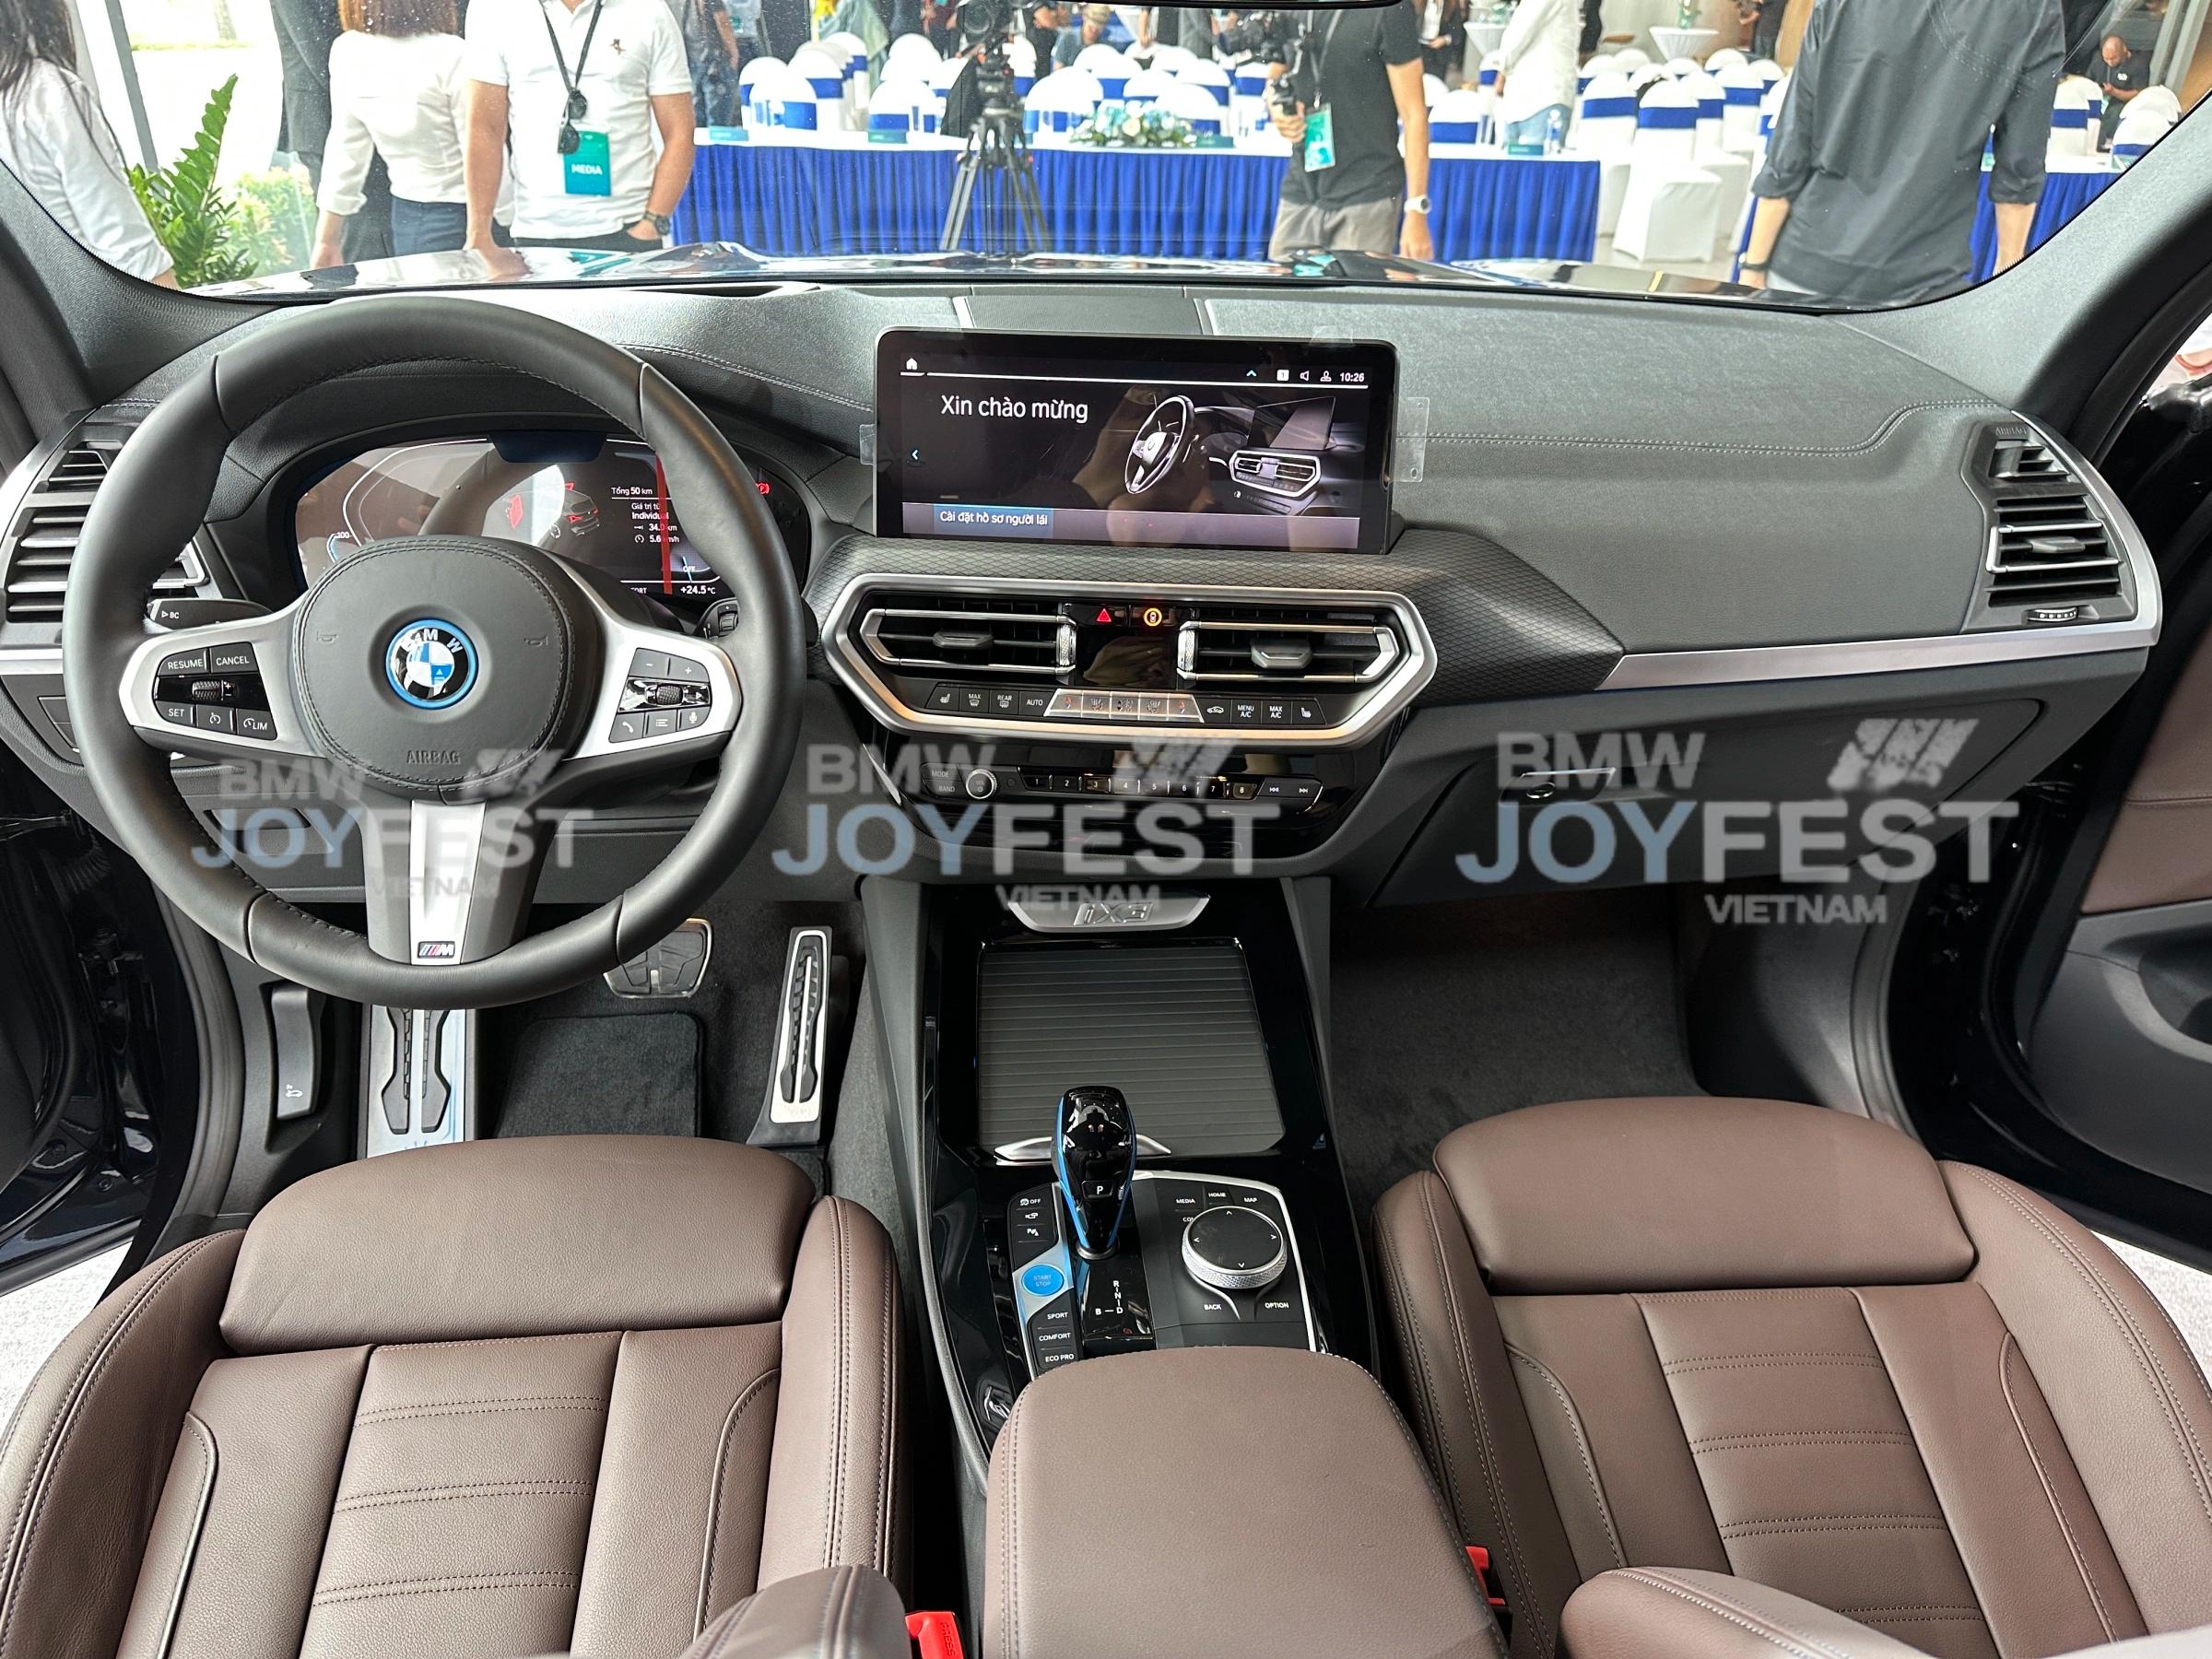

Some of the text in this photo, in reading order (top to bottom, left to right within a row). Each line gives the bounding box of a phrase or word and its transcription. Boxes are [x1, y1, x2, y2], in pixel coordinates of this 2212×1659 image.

[571, 164, 603, 175] MEDIA
[1340, 372, 1364, 382] 10:26
[940, 394, 1088, 423] Xin chào mừng
[611, 487, 630, 496] Tổng
[940, 511, 1047, 525] Cài đặt hồ sơ người lái
[680, 584, 706, 594] +24.5
[168, 659, 203, 669] RESUME
[216, 655, 249, 665] CANCEL
[168, 708, 184, 717] SET
[253, 722, 267, 731] LIM
[406, 749, 461, 765] AIRBAG
[1097, 1185, 1104, 1194] P
[1039, 1333, 1071, 1342] COMFORT
